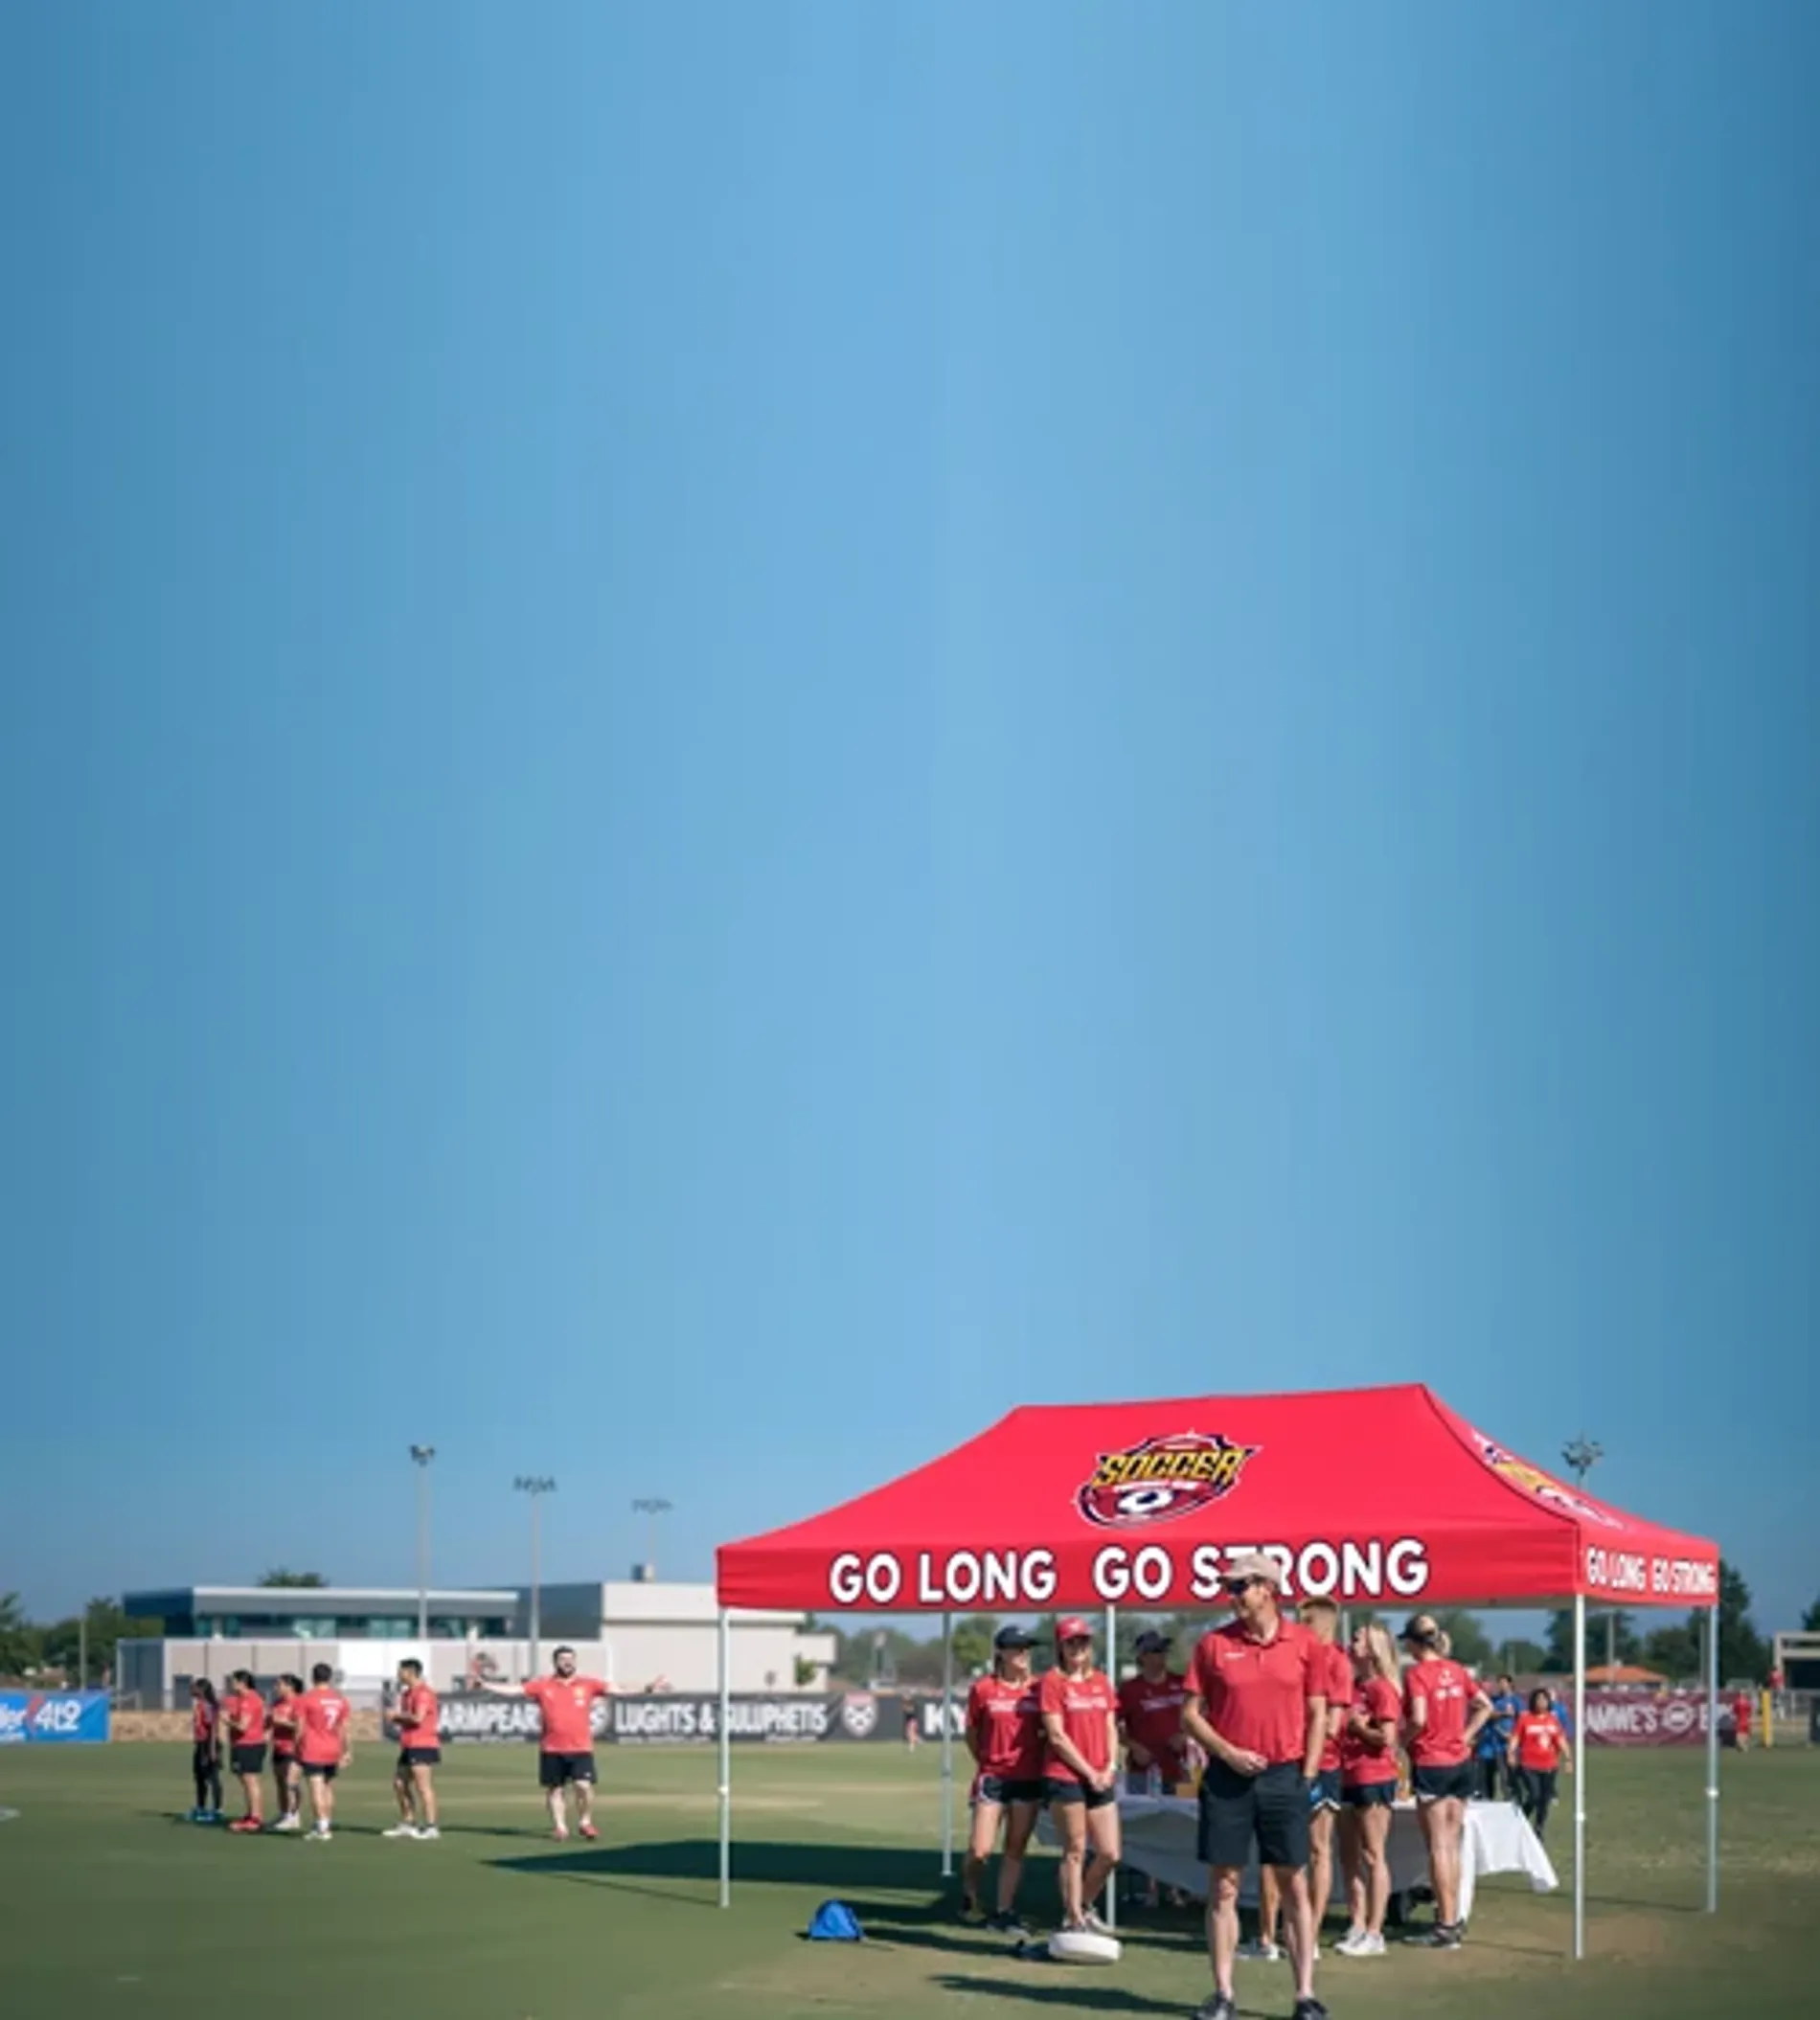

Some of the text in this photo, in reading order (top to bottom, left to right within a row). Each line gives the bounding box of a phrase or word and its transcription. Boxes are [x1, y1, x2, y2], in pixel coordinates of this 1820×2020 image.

[1090, 1449, 1246, 1488] SOCCER
[830, 1552, 902, 1603] GO
[919, 1548, 1058, 1603] LONG
[1093, 1545, 1173, 1600] GO
